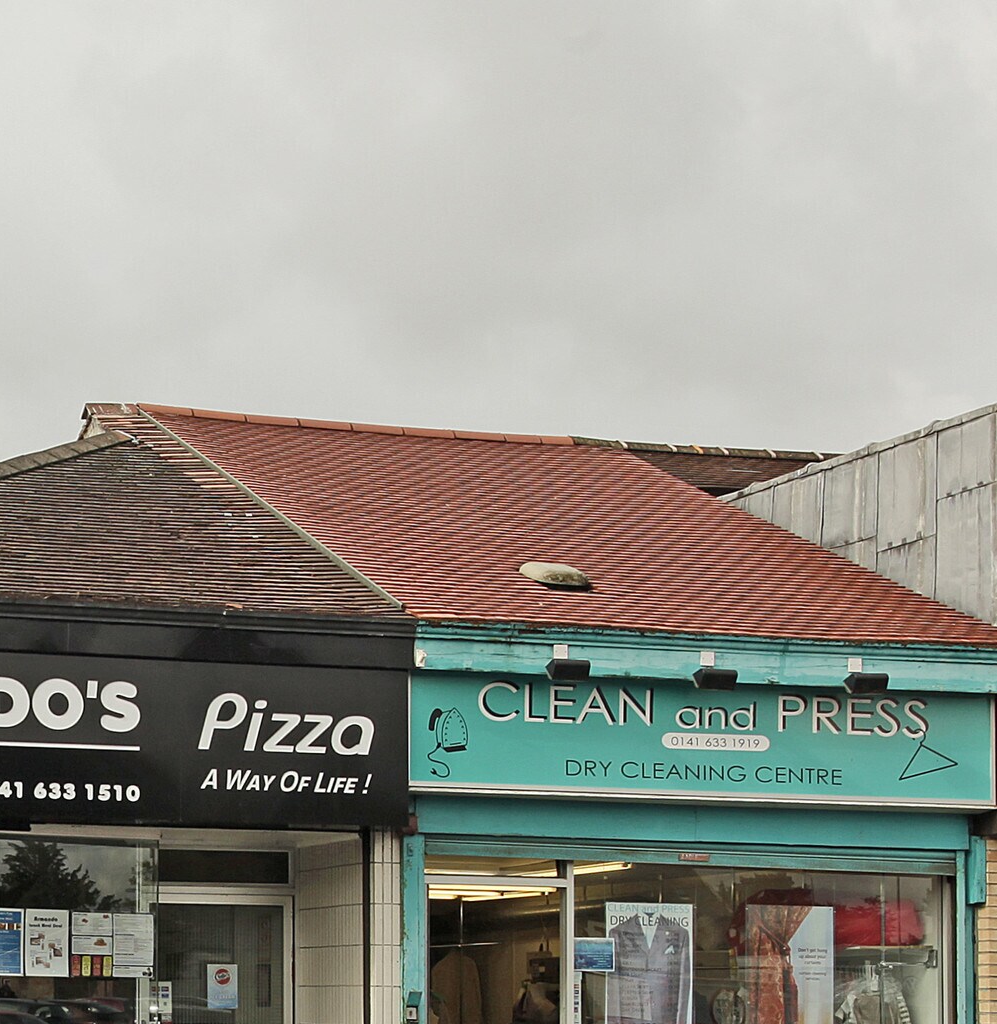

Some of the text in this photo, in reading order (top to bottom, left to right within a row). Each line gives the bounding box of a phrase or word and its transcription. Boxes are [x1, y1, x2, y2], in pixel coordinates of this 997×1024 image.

[478, 680, 930, 738] CLEAN and PRESS
[198, 692, 375, 756] Pizza
[671, 736, 761, 750] 0141 633 1919
[200, 768, 219, 790] A
[565, 759, 843, 786] DRY CLEANING CENTRE
[33, 782, 77, 800] 633
[84, 783, 141, 802] 1510
[607, 903, 690, 914] CLEAN and PRESS
[610, 915, 689, 928] DRY CLEANING
